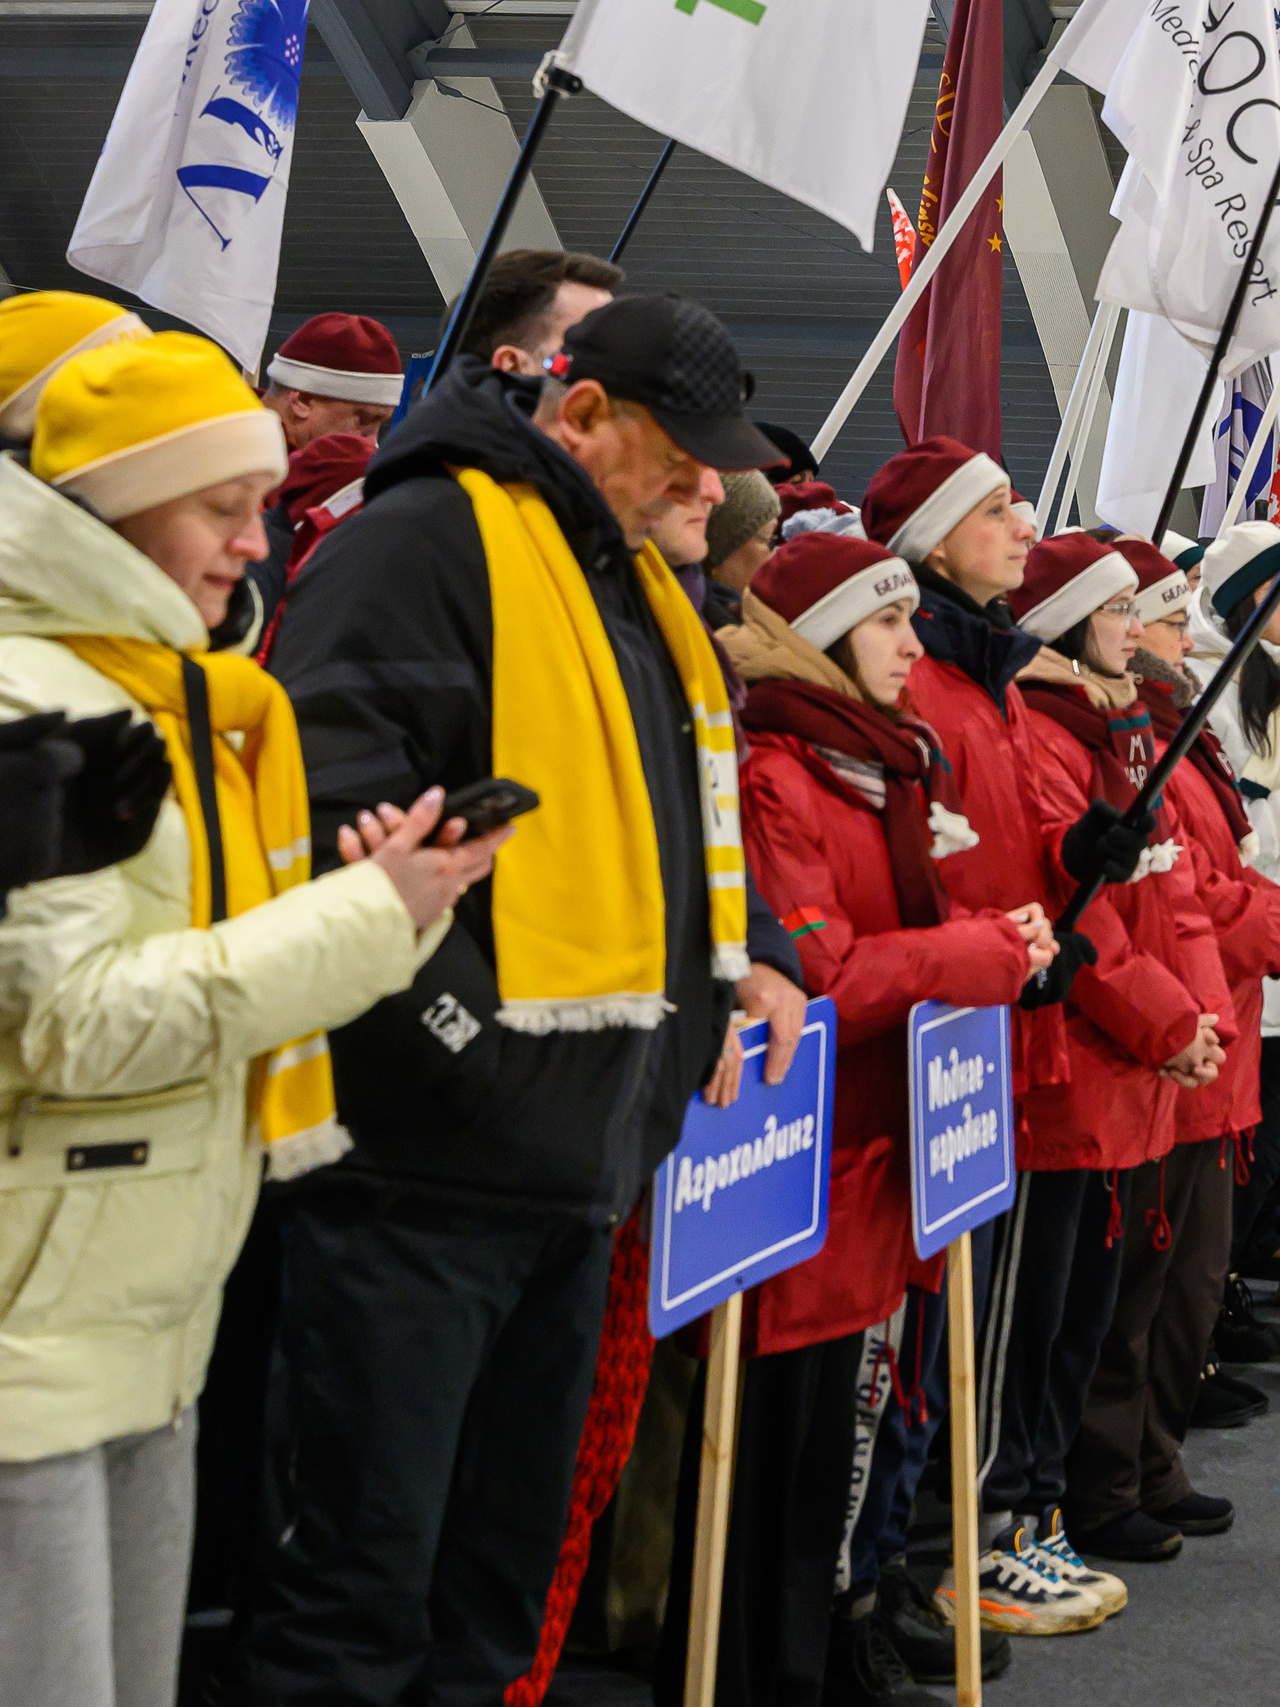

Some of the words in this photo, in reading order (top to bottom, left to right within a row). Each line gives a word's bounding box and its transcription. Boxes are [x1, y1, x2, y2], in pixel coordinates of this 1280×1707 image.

[1186, 138, 1223, 190] Spa
[1215, 193, 1277, 307] Resort
[674, 1113, 815, 1213] Агрохолдинг
